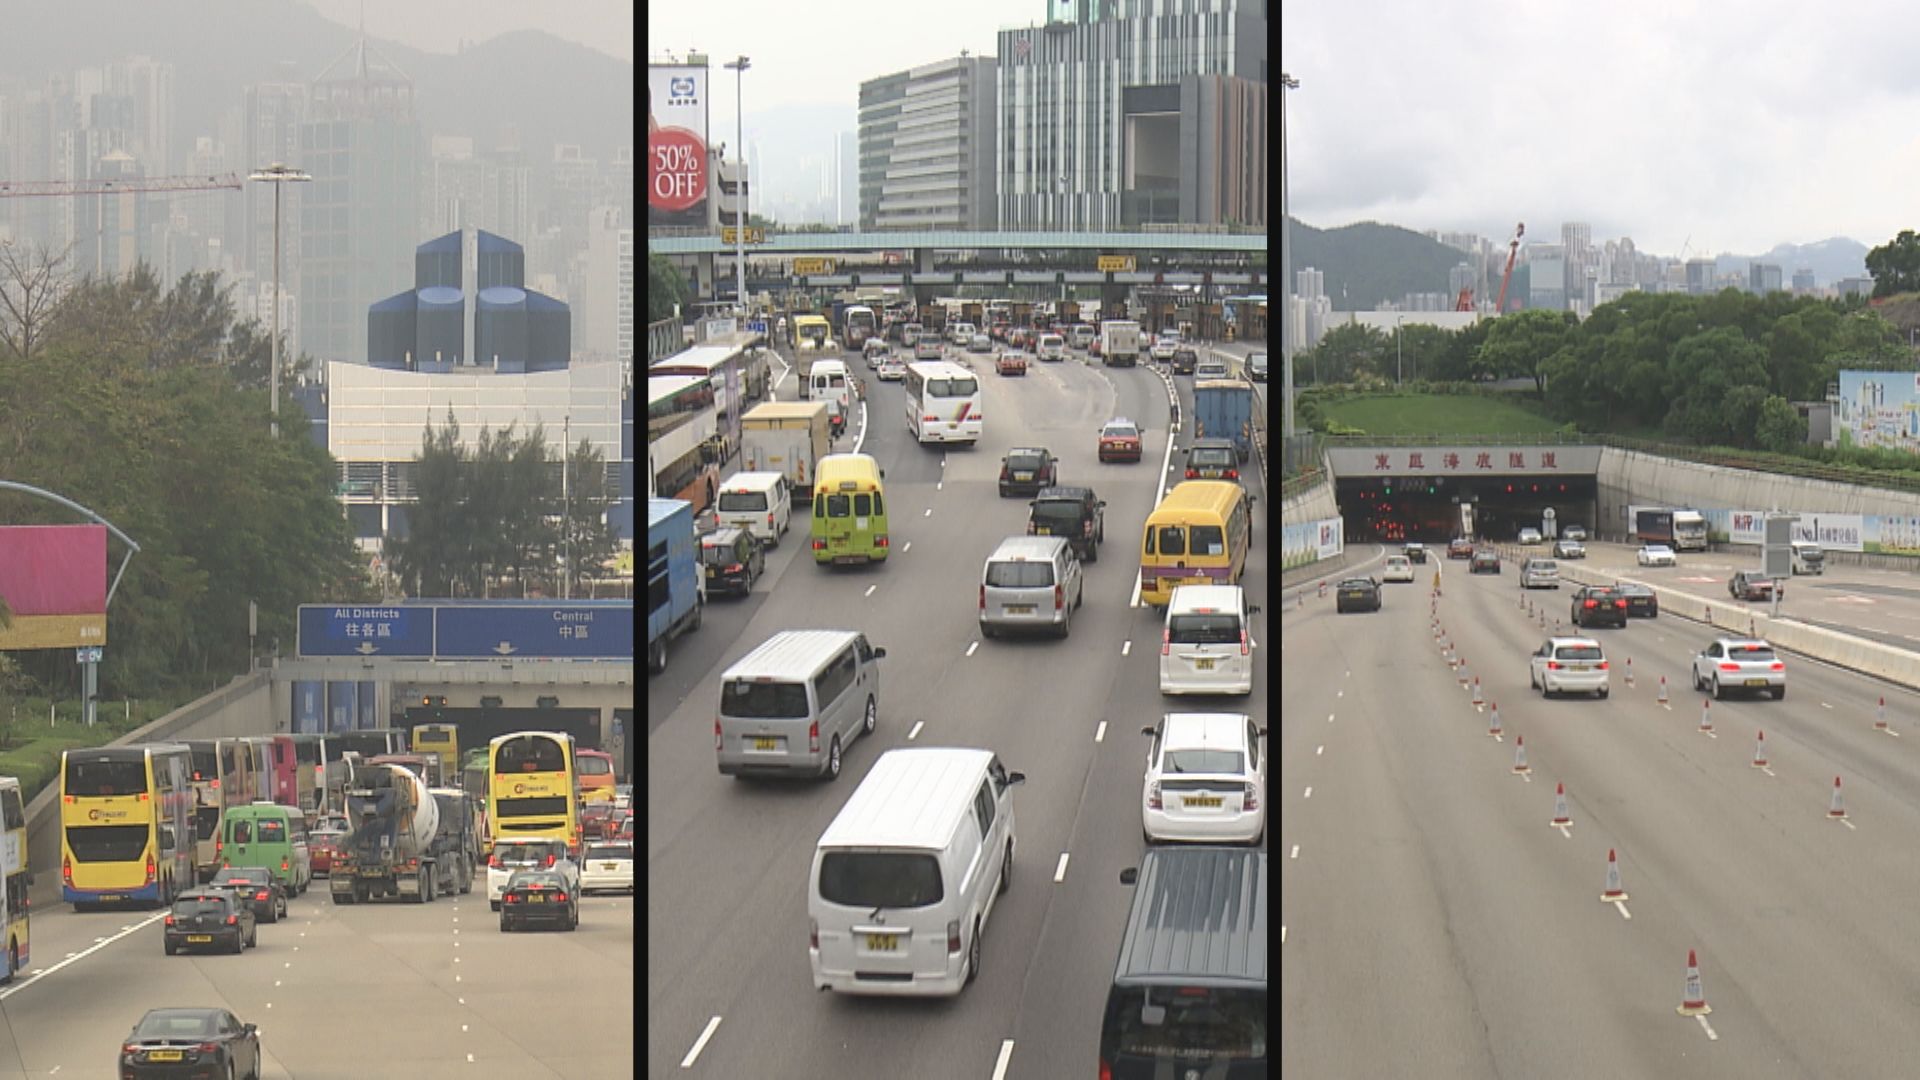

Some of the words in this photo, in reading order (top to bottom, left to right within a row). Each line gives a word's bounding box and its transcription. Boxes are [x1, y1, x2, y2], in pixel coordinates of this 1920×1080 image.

[655, 145, 698, 171] 50%
[655, 172, 698, 198] OFF
[1375, 452, 1557, 470] 東區海底隧道
[334, 608, 350, 619] All
[353, 608, 400, 619] Districts
[552, 611, 594, 622] Central
[345, 623, 392, 638] 往各區
[559, 625, 589, 640] 中區
